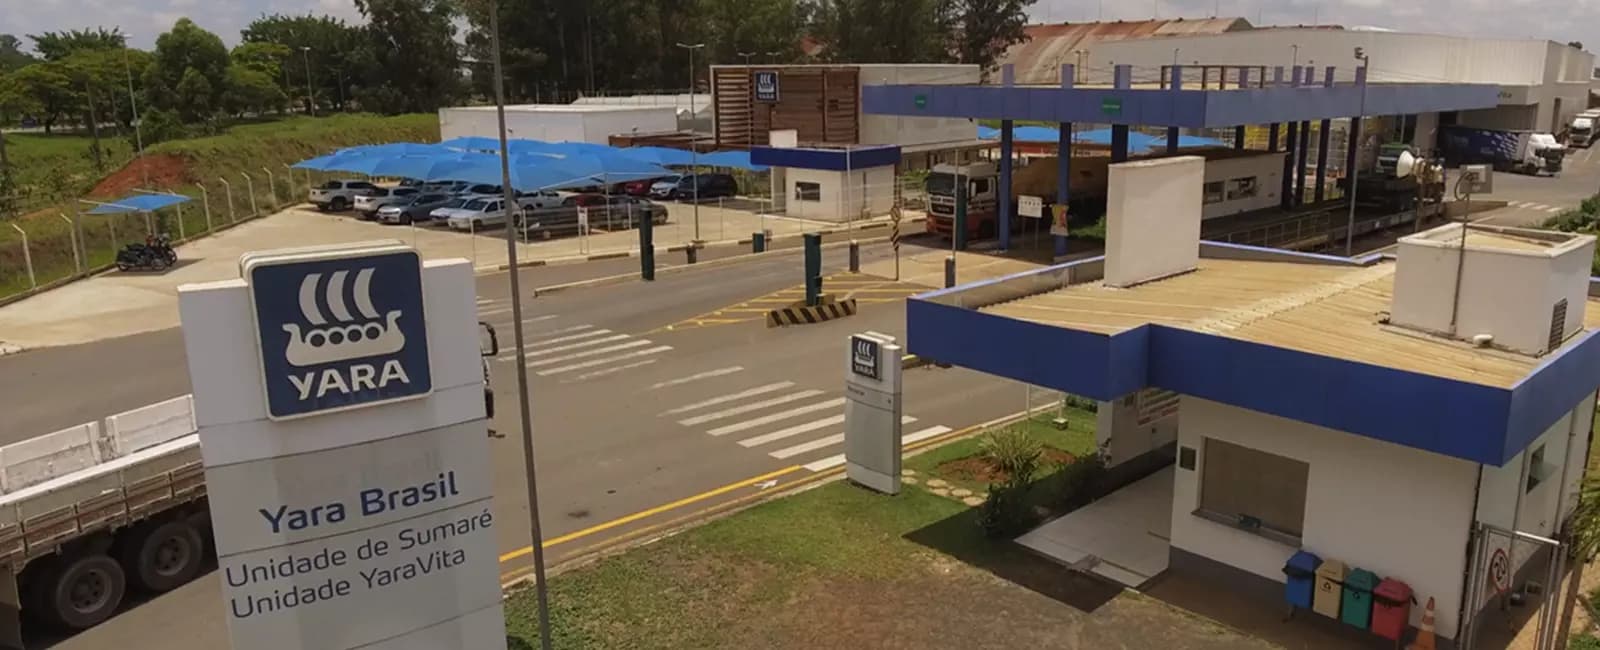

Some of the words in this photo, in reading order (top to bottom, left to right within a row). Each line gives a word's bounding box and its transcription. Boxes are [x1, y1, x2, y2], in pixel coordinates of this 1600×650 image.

[288, 359, 410, 400] YARA
[855, 363, 874, 376] YARA
[259, 505, 346, 534] Yara
[360, 471, 459, 516] Brasil
[226, 548, 347, 587] Unidade
[357, 538, 389, 560] de
[398, 508, 492, 550] Sumaré
[1494, 556, 1506, 582] 20
[231, 579, 350, 618] Unidade
[360, 549, 465, 589] YaraVita
